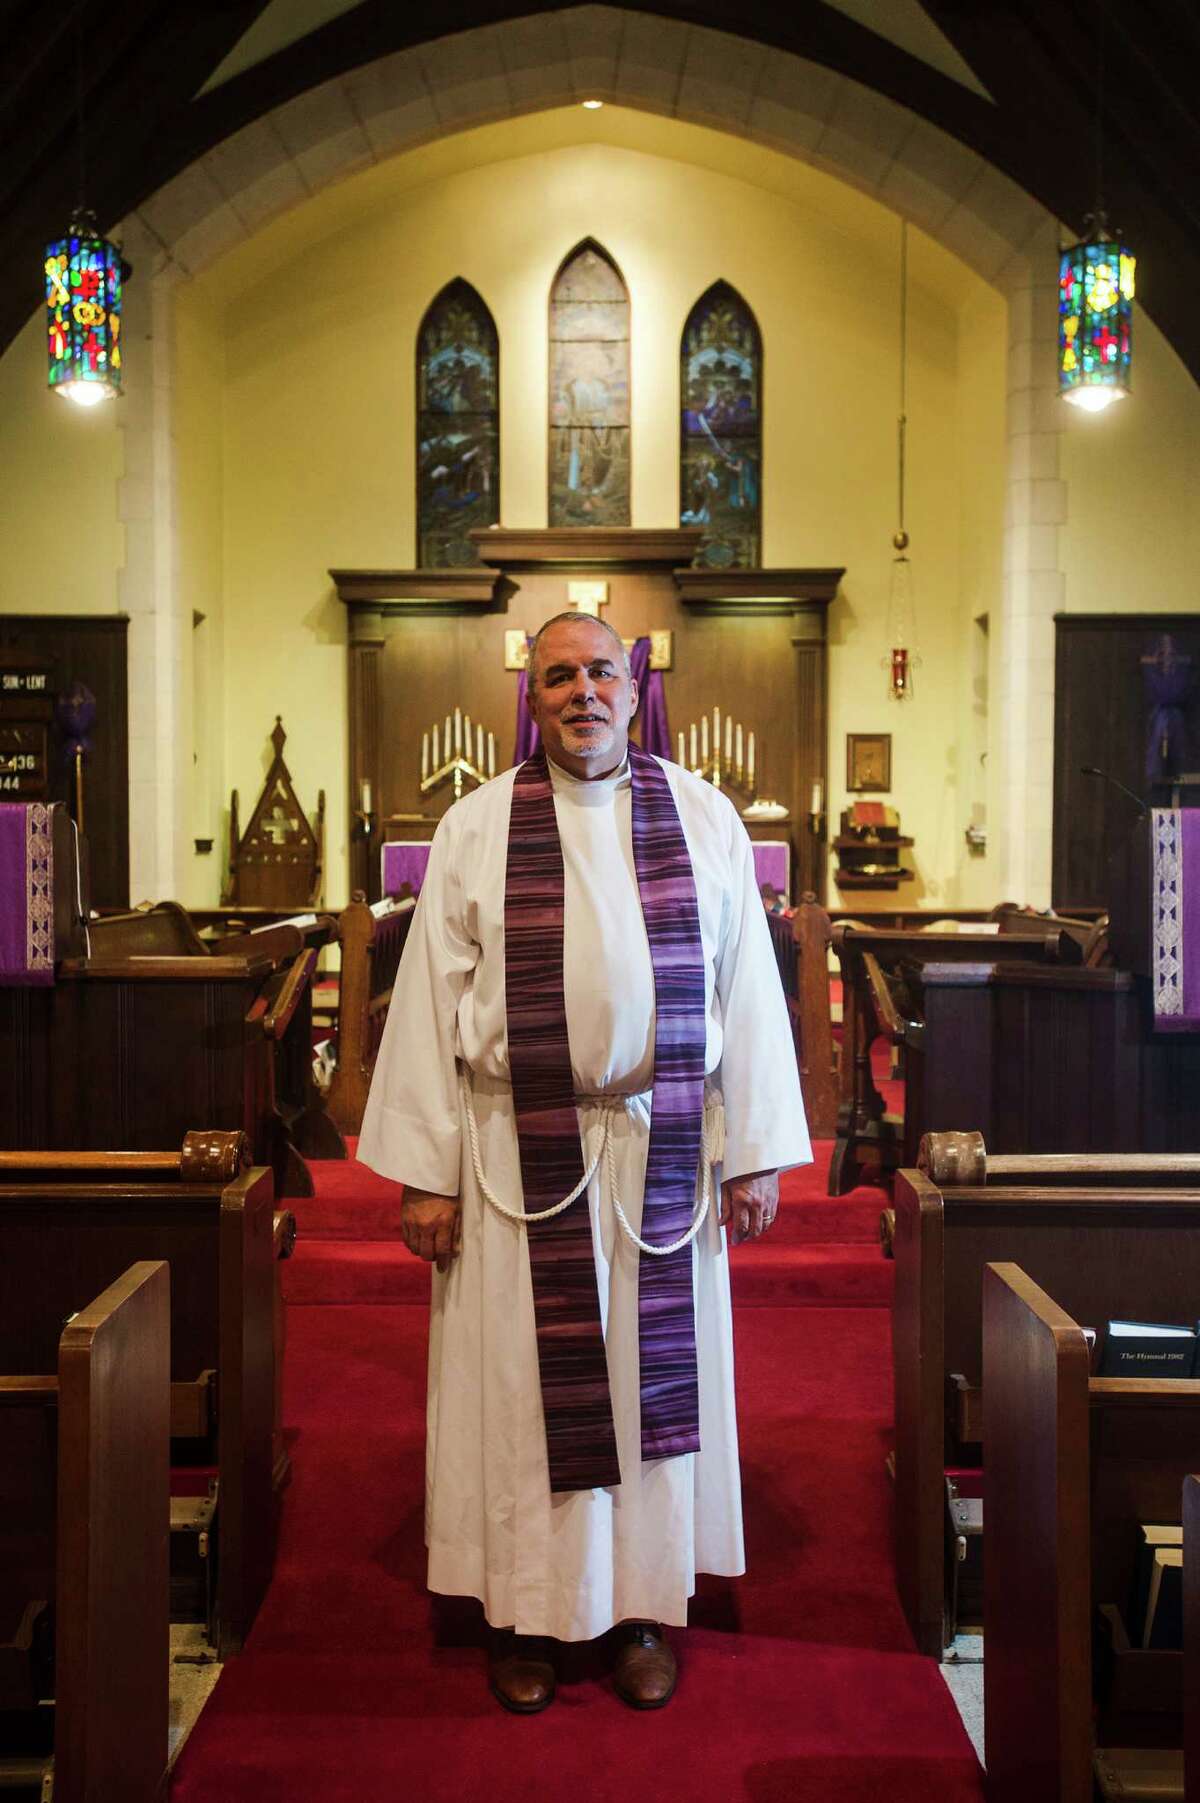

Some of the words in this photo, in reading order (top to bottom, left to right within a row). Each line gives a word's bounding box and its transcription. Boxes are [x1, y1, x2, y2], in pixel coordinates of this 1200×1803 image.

[26, 674, 46, 690] LENT
[1120, 1352, 1135, 1360] The
[1136, 1352, 1167, 1361] Hymnal
